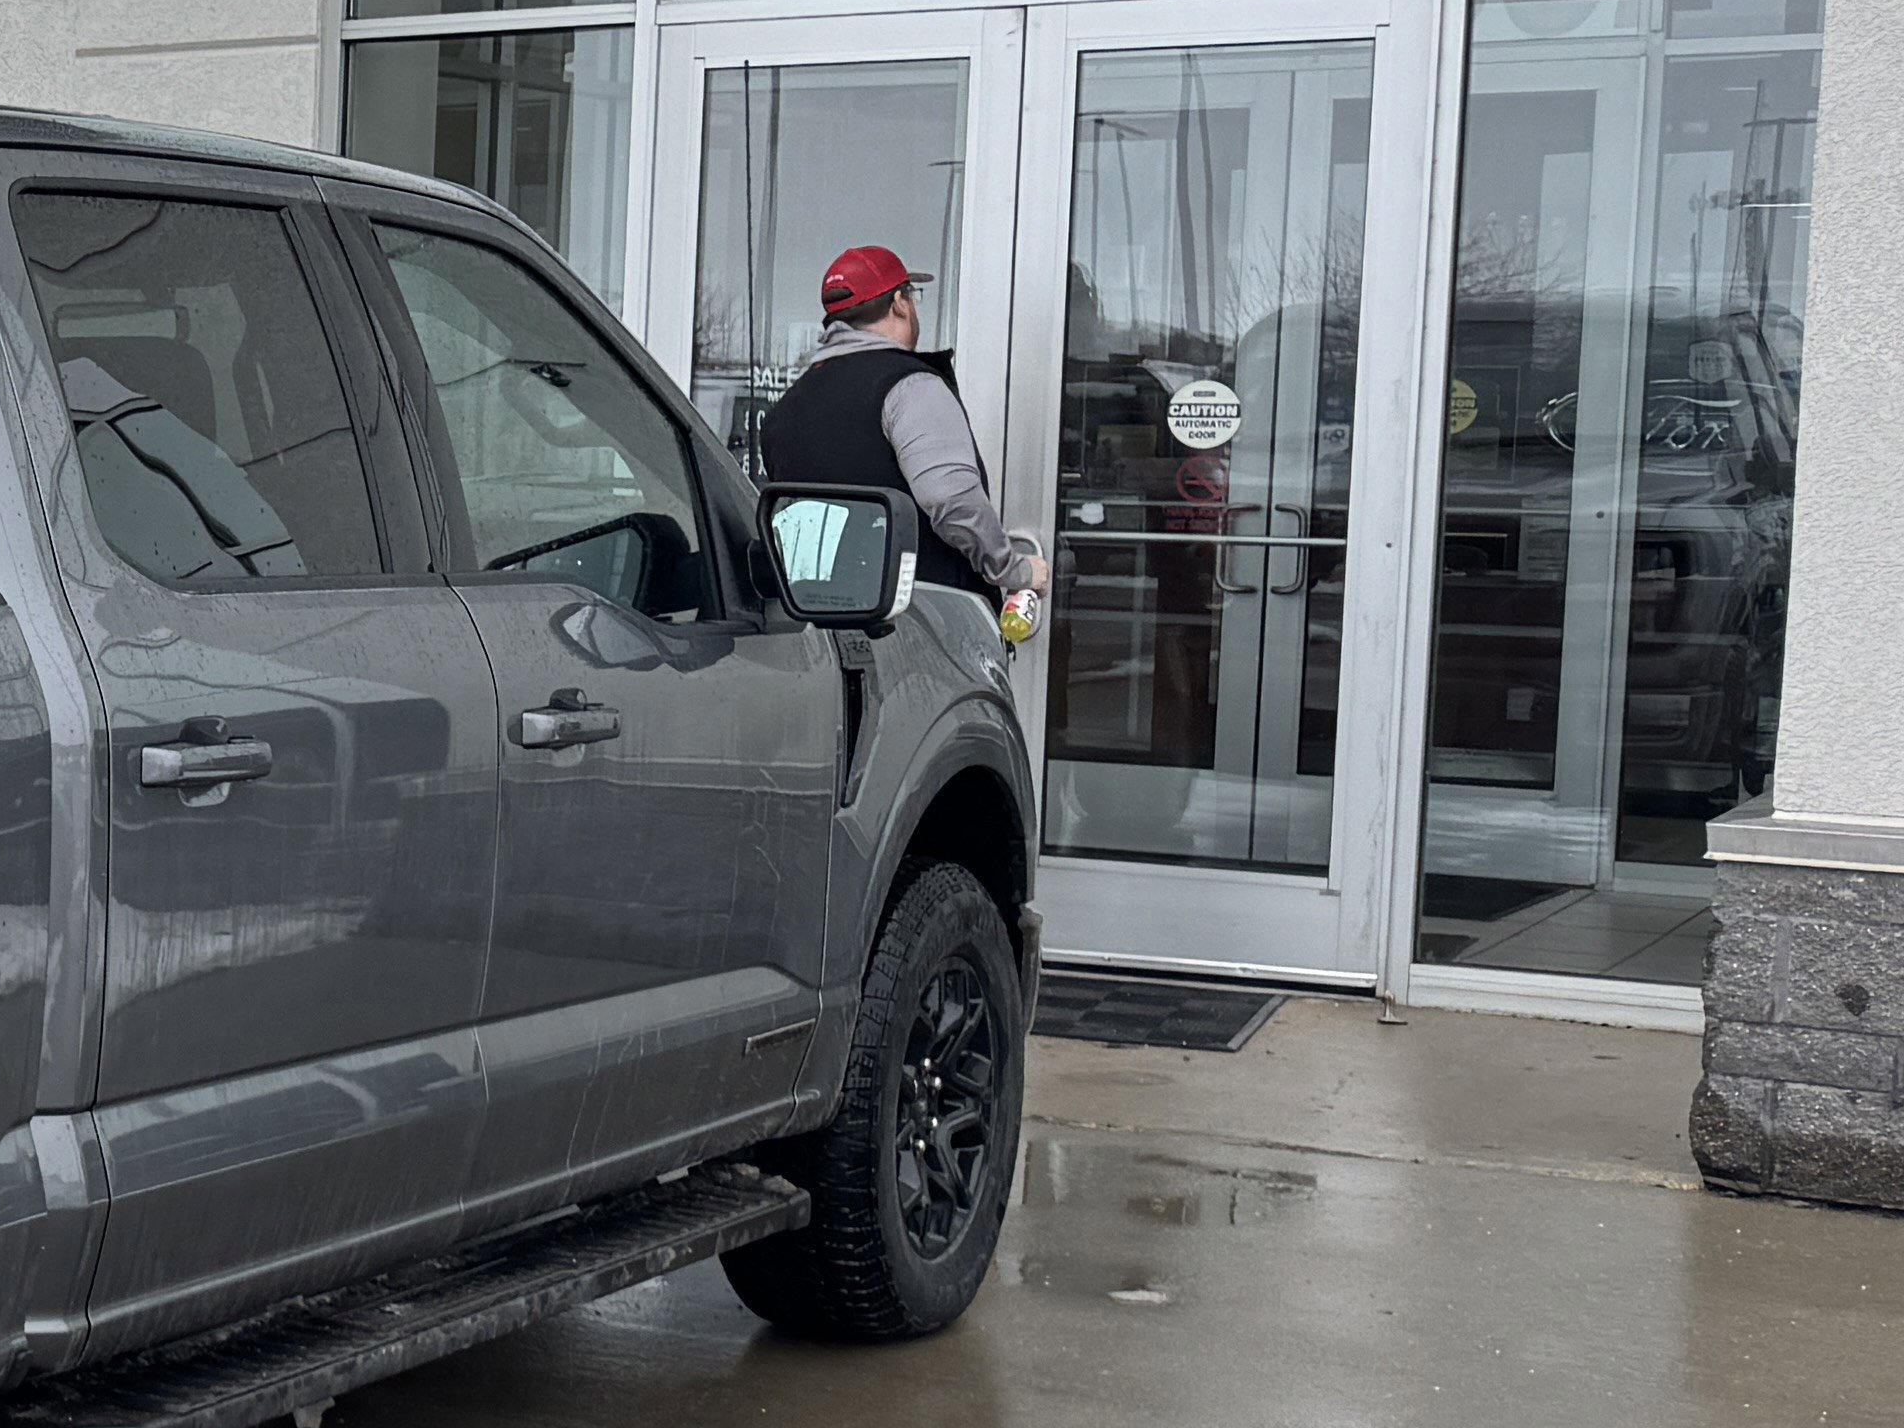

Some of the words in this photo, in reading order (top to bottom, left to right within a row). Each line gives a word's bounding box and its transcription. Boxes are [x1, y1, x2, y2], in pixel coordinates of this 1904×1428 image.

[1169, 404, 1238, 417] CAUTION
[1175, 420, 1232, 430] AUTOMATIC
[1188, 430, 1216, 440] DOOR
